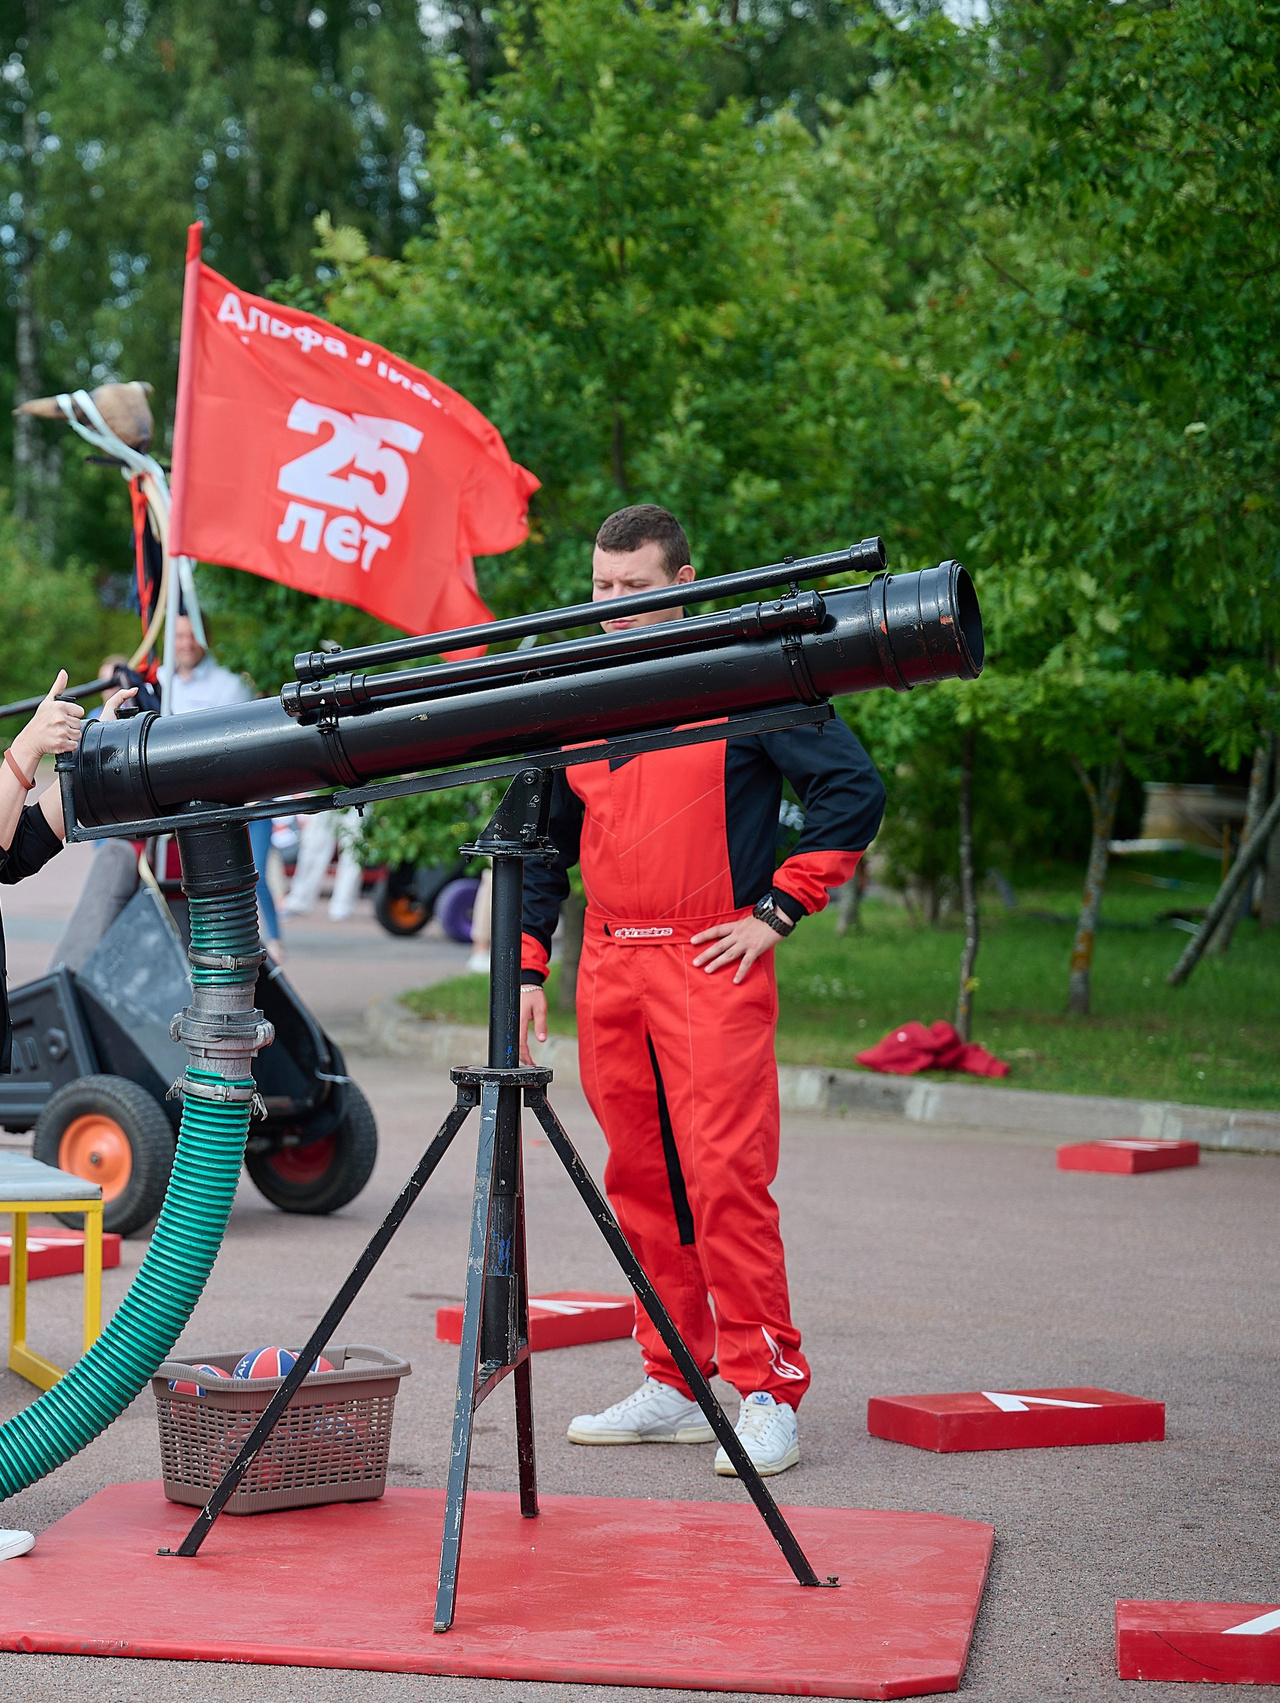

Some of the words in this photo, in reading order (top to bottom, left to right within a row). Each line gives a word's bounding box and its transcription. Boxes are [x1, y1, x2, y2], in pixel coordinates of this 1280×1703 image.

[217, 292, 347, 358] Альфа
[277, 397, 424, 525] 25
[276, 500, 391, 572] лет
